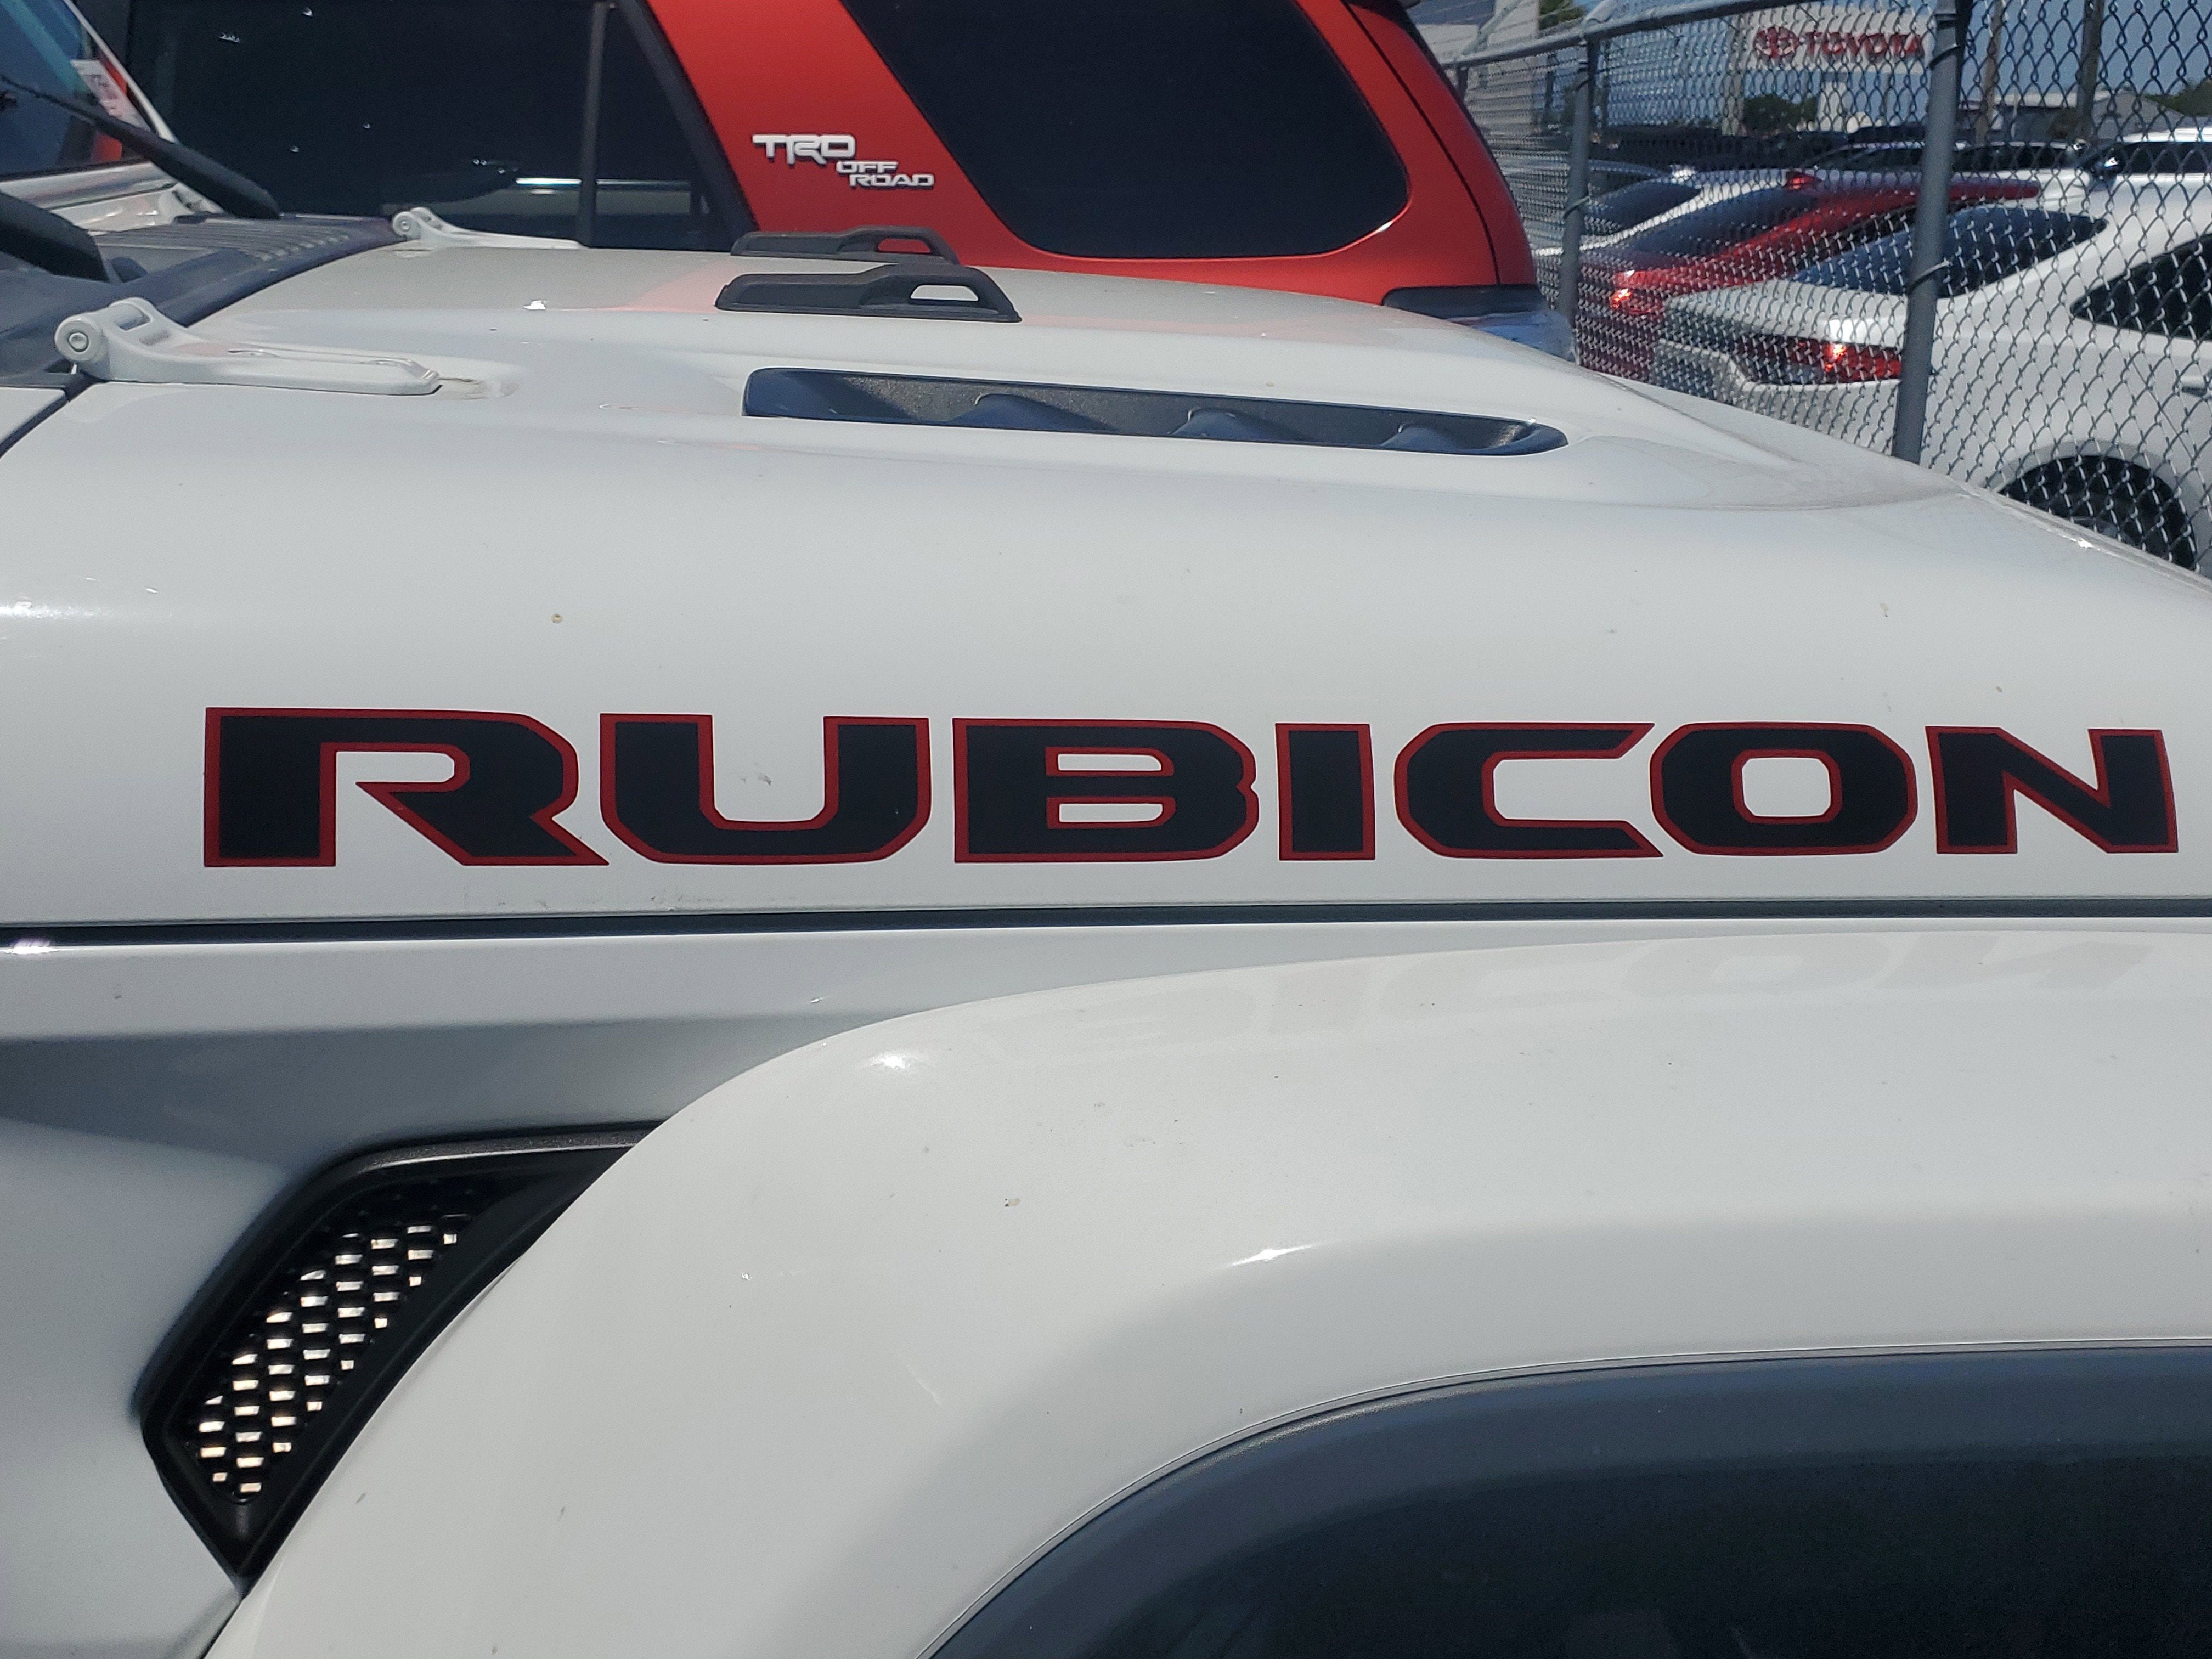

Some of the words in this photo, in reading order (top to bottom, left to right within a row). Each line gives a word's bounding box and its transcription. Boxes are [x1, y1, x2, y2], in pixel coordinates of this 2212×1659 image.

[1805, 32, 1924, 58] TOYOTA
[752, 134, 855, 165] TRD
[836, 161, 899, 174] OFF
[849, 173, 934, 187] ROAD
[204, 707, 2179, 867] RUBICON
